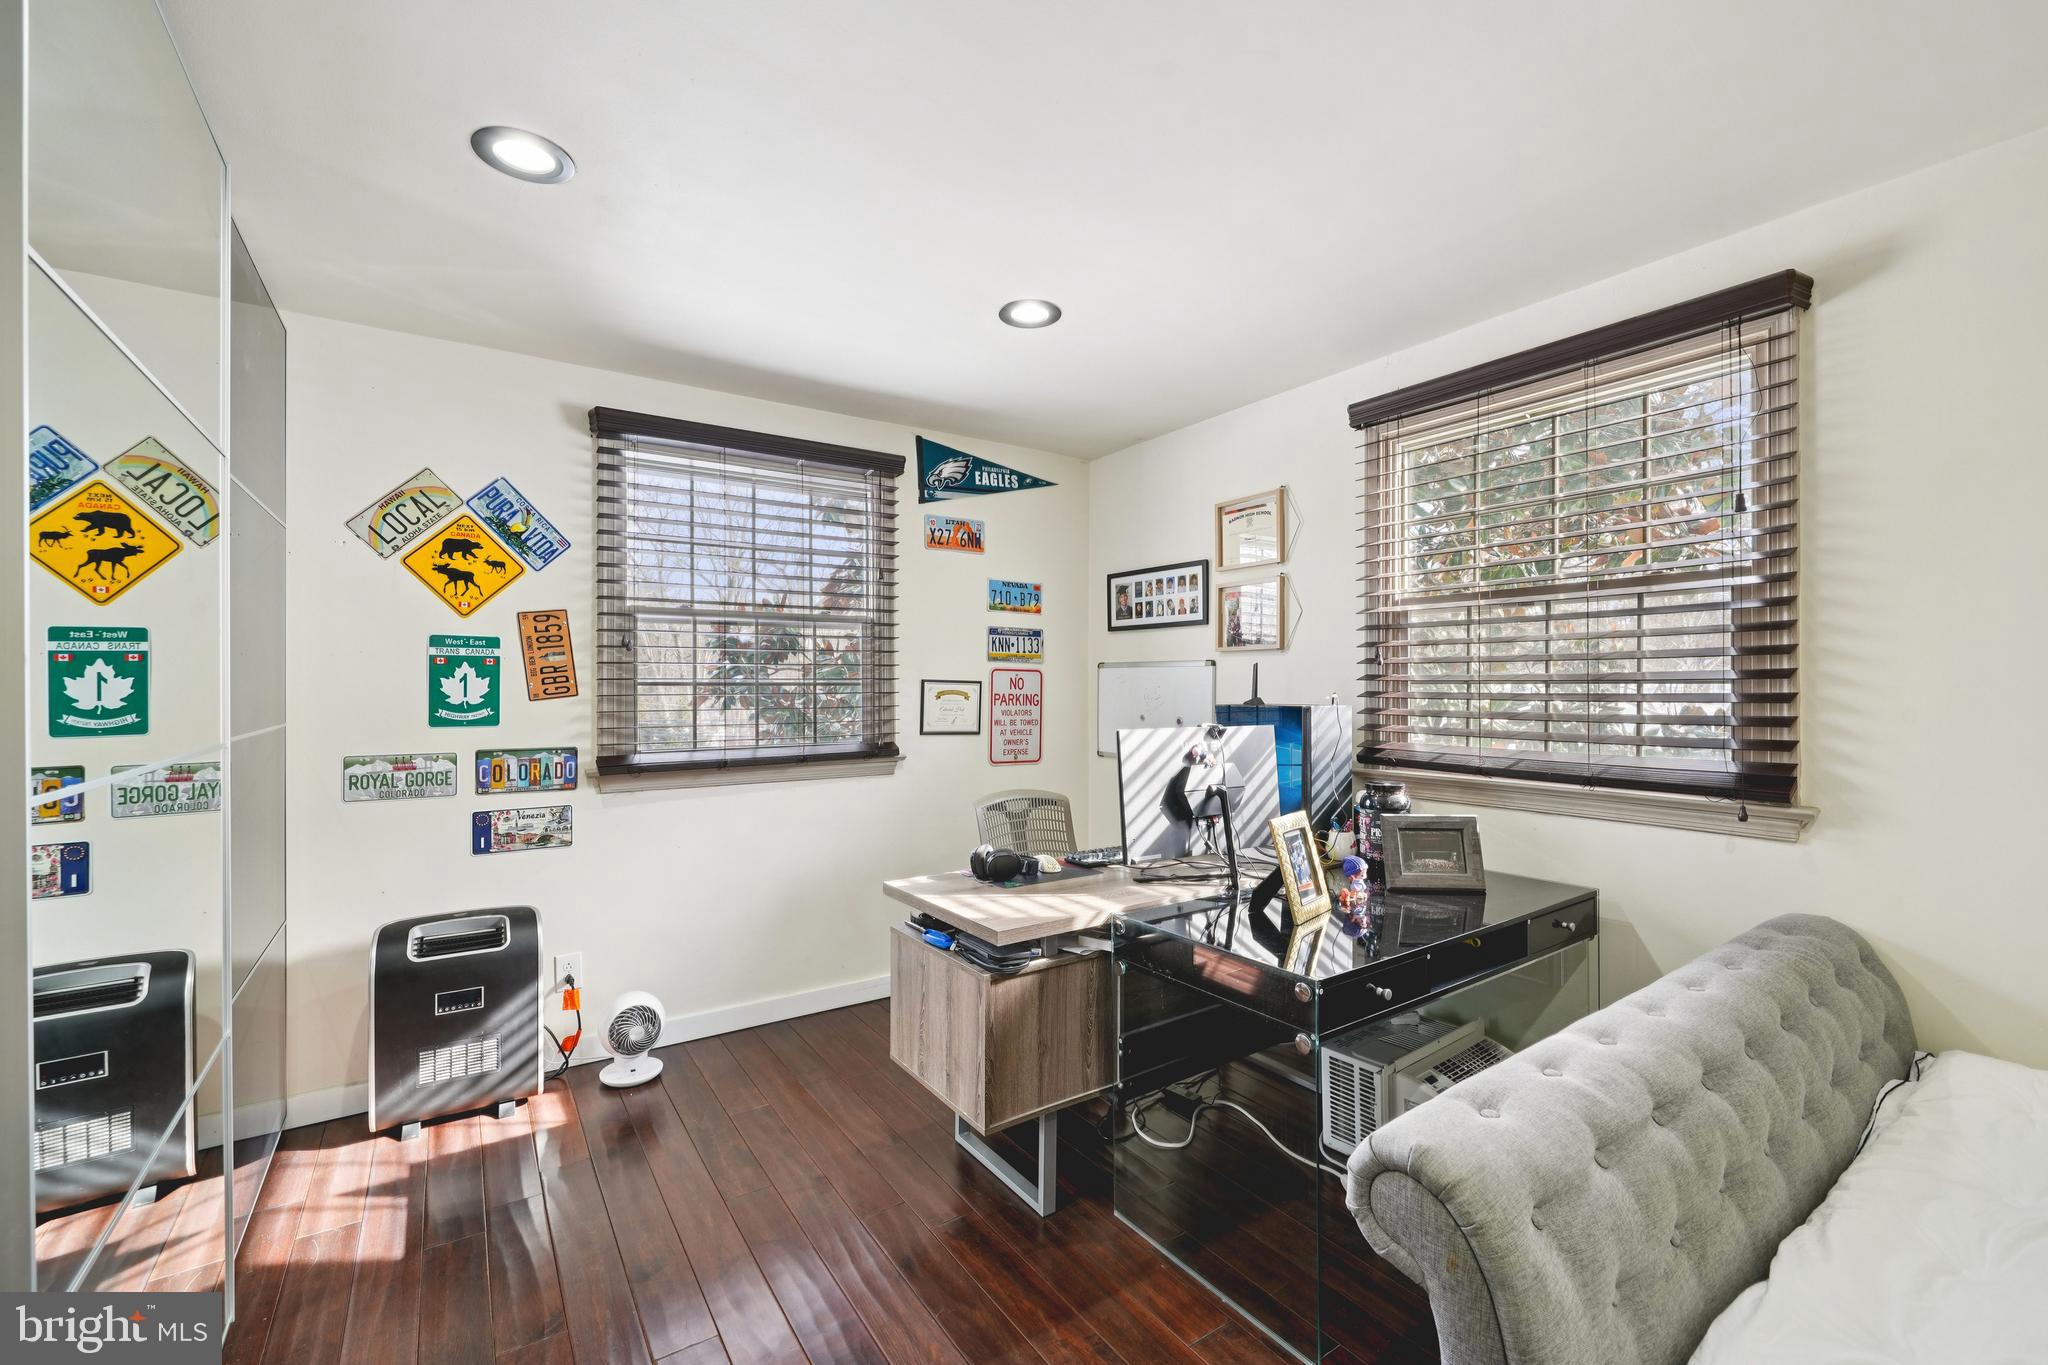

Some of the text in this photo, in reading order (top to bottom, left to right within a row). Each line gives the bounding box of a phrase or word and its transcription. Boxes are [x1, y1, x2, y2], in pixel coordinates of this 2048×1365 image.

[975, 471, 1019, 488] EAGLES
[379, 490, 406, 510] HAWAII
[368, 490, 446, 544] LOCAL
[477, 486, 559, 563] PURA VIDA
[536, 517, 551, 532] RICA
[945, 519, 966, 527] UTAH
[401, 512, 442, 543] ALOHA STATE
[930, 527, 951, 545] X27
[1002, 581, 1028, 589] NEVADA
[532, 614, 571, 696] GBR 1859
[459, 673, 468, 698] 1
[1009, 677, 1024, 690] NO
[994, 693, 1039, 706] PARKING
[1009, 728, 1032, 736] VEHICLE
[1003, 738, 1029, 746] OWNER'S
[1003, 748, 1029, 756] EXPENSE
[479, 761, 576, 783] COLORADO
[348, 771, 453, 791] ROYAL GORGE
[380, 789, 425, 799] COLORADO
[517, 810, 546, 819] Venezia
